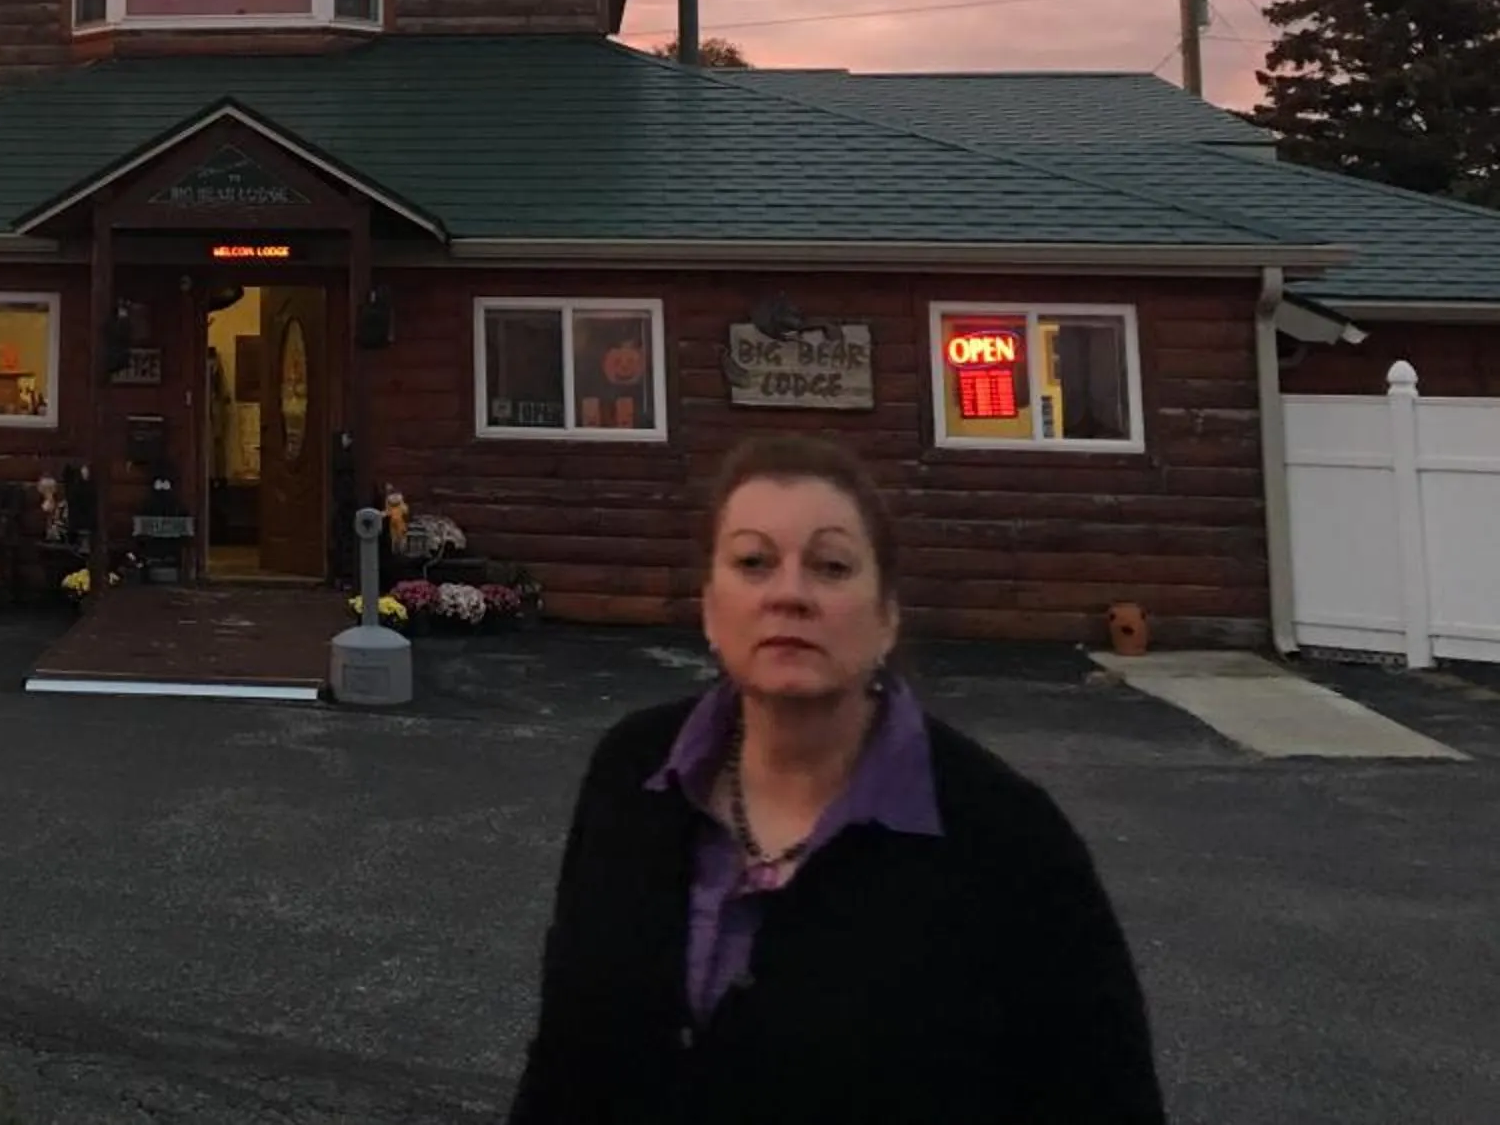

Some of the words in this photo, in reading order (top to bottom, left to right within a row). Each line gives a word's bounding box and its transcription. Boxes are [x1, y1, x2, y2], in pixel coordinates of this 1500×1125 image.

[256, 245, 290, 257] LODGE
[737, 338, 783, 367] BIG
[798, 339, 869, 370] BEAR
[948, 336, 1016, 364] OPEN
[760, 372, 843, 398] LODGE
